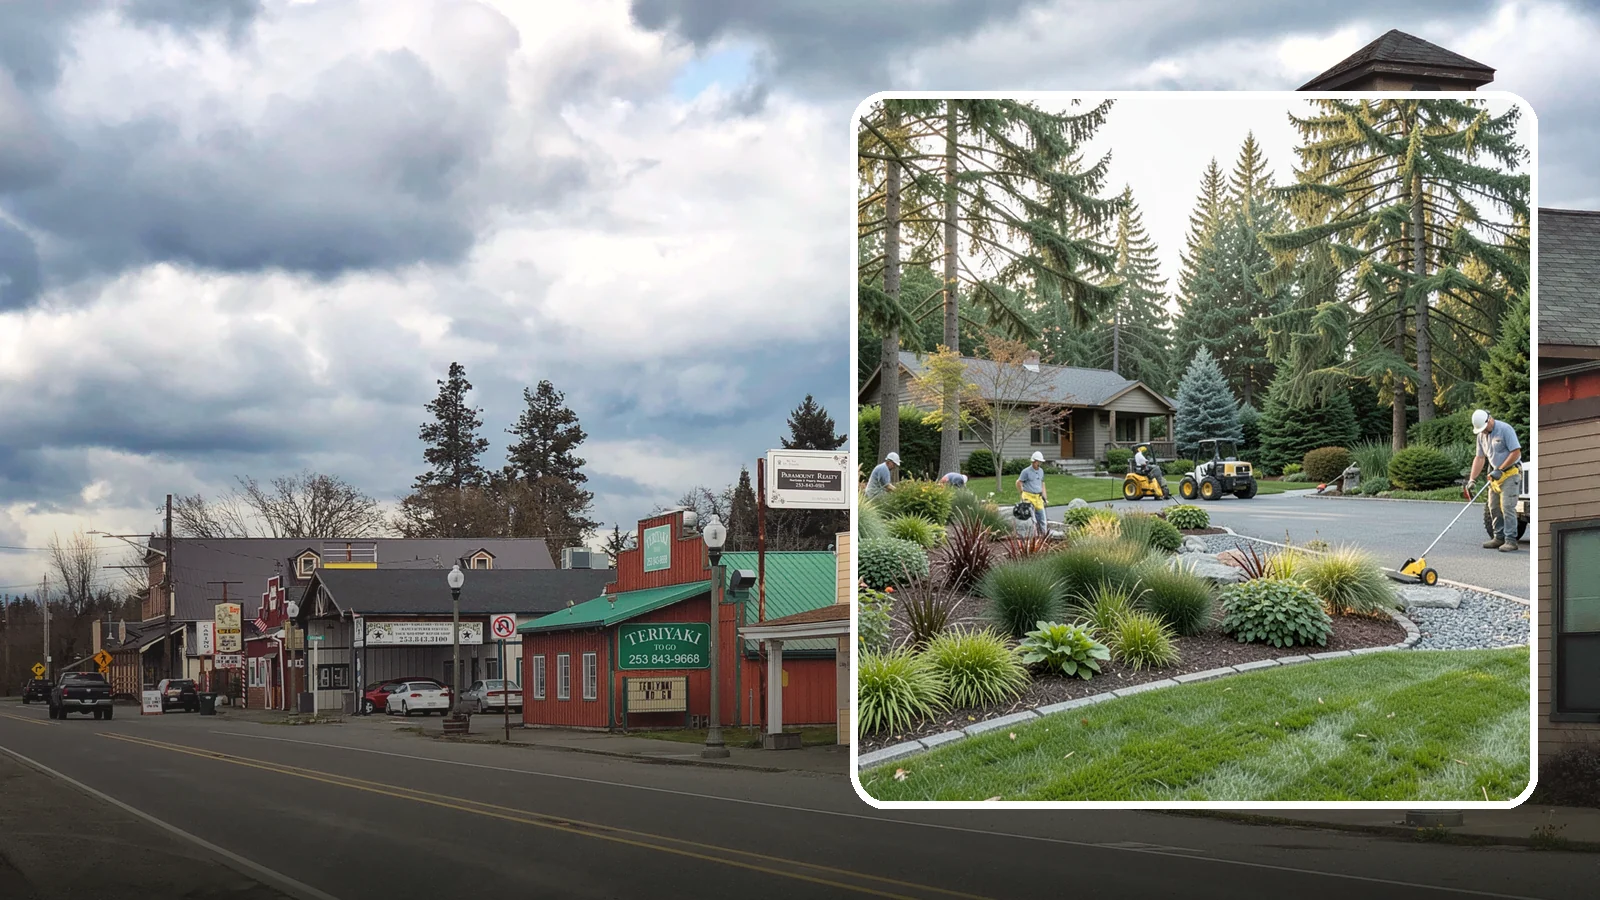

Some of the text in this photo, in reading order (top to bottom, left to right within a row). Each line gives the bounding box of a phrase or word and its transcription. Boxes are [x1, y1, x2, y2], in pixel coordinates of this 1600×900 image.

[781, 471, 839, 480] PARAMOUNT REALTY
[624, 627, 702, 646] TERIYAKI
[629, 653, 700, 664] 253 843-9668
